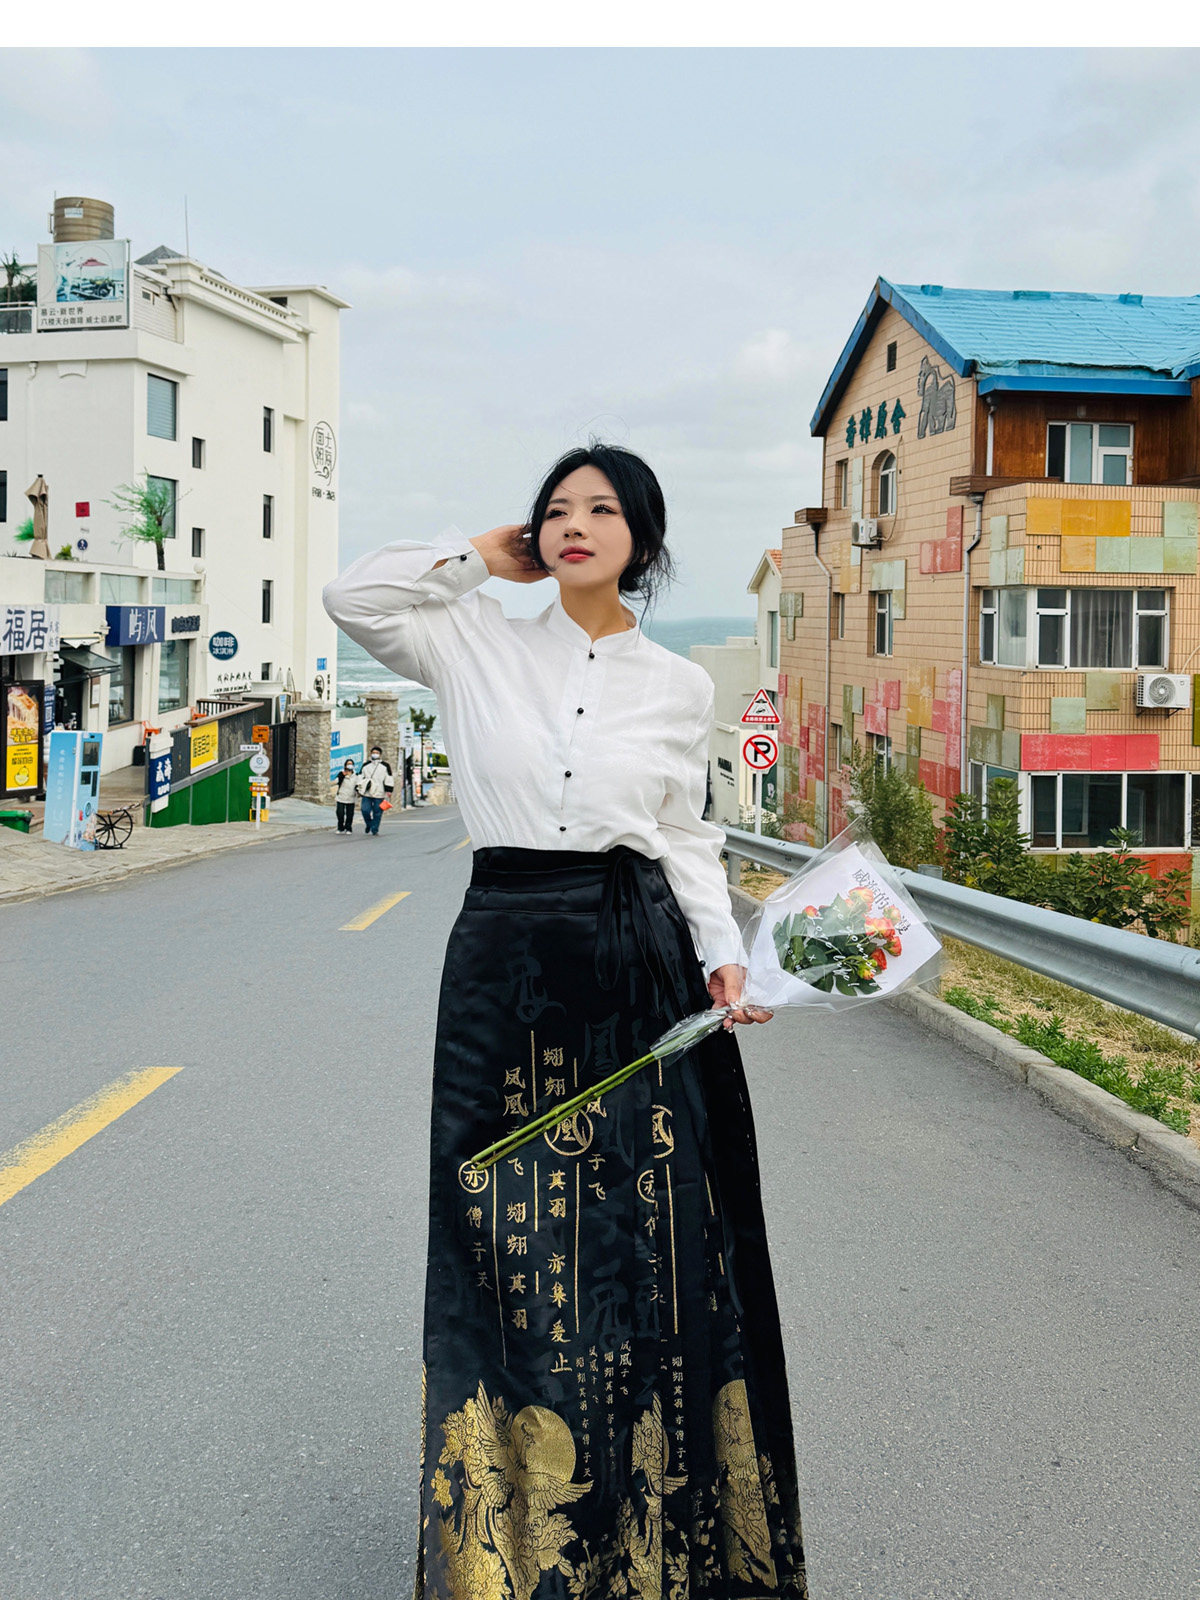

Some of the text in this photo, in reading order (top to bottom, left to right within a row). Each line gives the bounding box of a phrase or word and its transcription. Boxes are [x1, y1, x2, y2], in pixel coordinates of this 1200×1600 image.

[2, 608, 48, 652] 福居
[212, 636, 235, 647] 咖啡
[852, 868, 912, 935] 威海的漫
